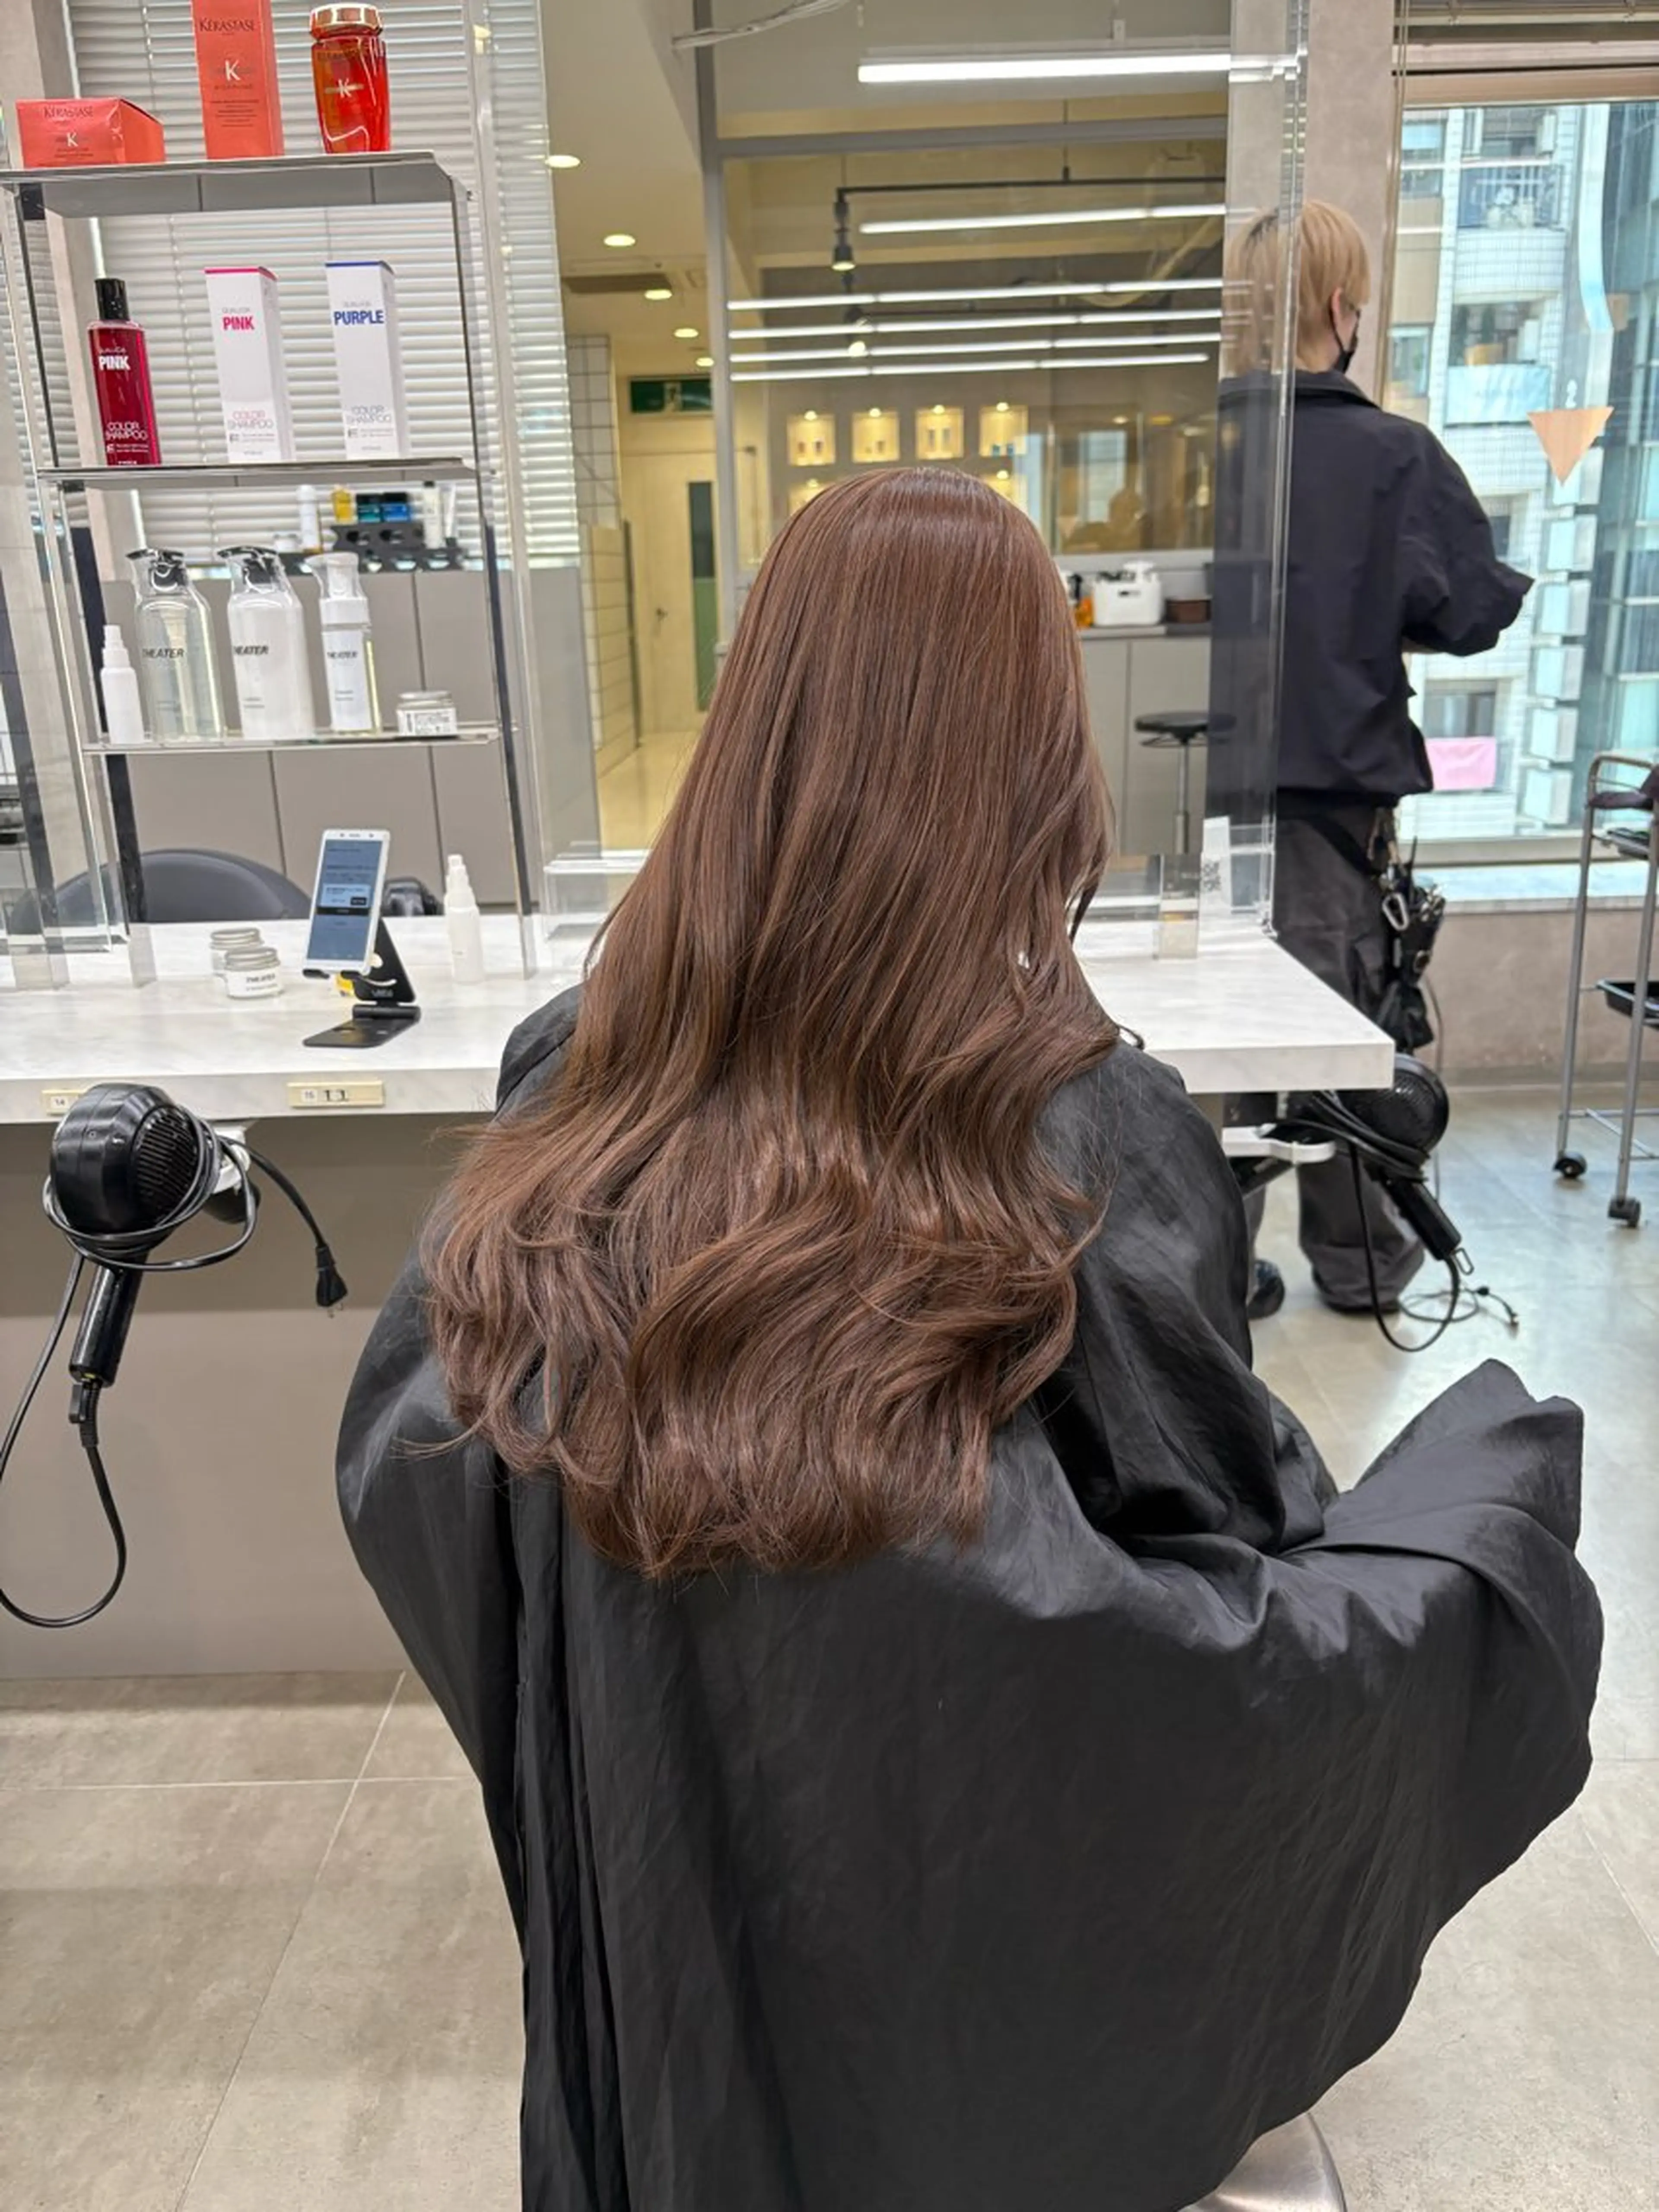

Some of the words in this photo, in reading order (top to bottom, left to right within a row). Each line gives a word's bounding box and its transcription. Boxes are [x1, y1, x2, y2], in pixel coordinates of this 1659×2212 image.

[225, 60, 241, 81] K
[67, 132, 79, 147] K
[223, 316, 255, 331] PINK
[334, 310, 384, 325] PURPLE
[99, 356, 131, 370] PINK
